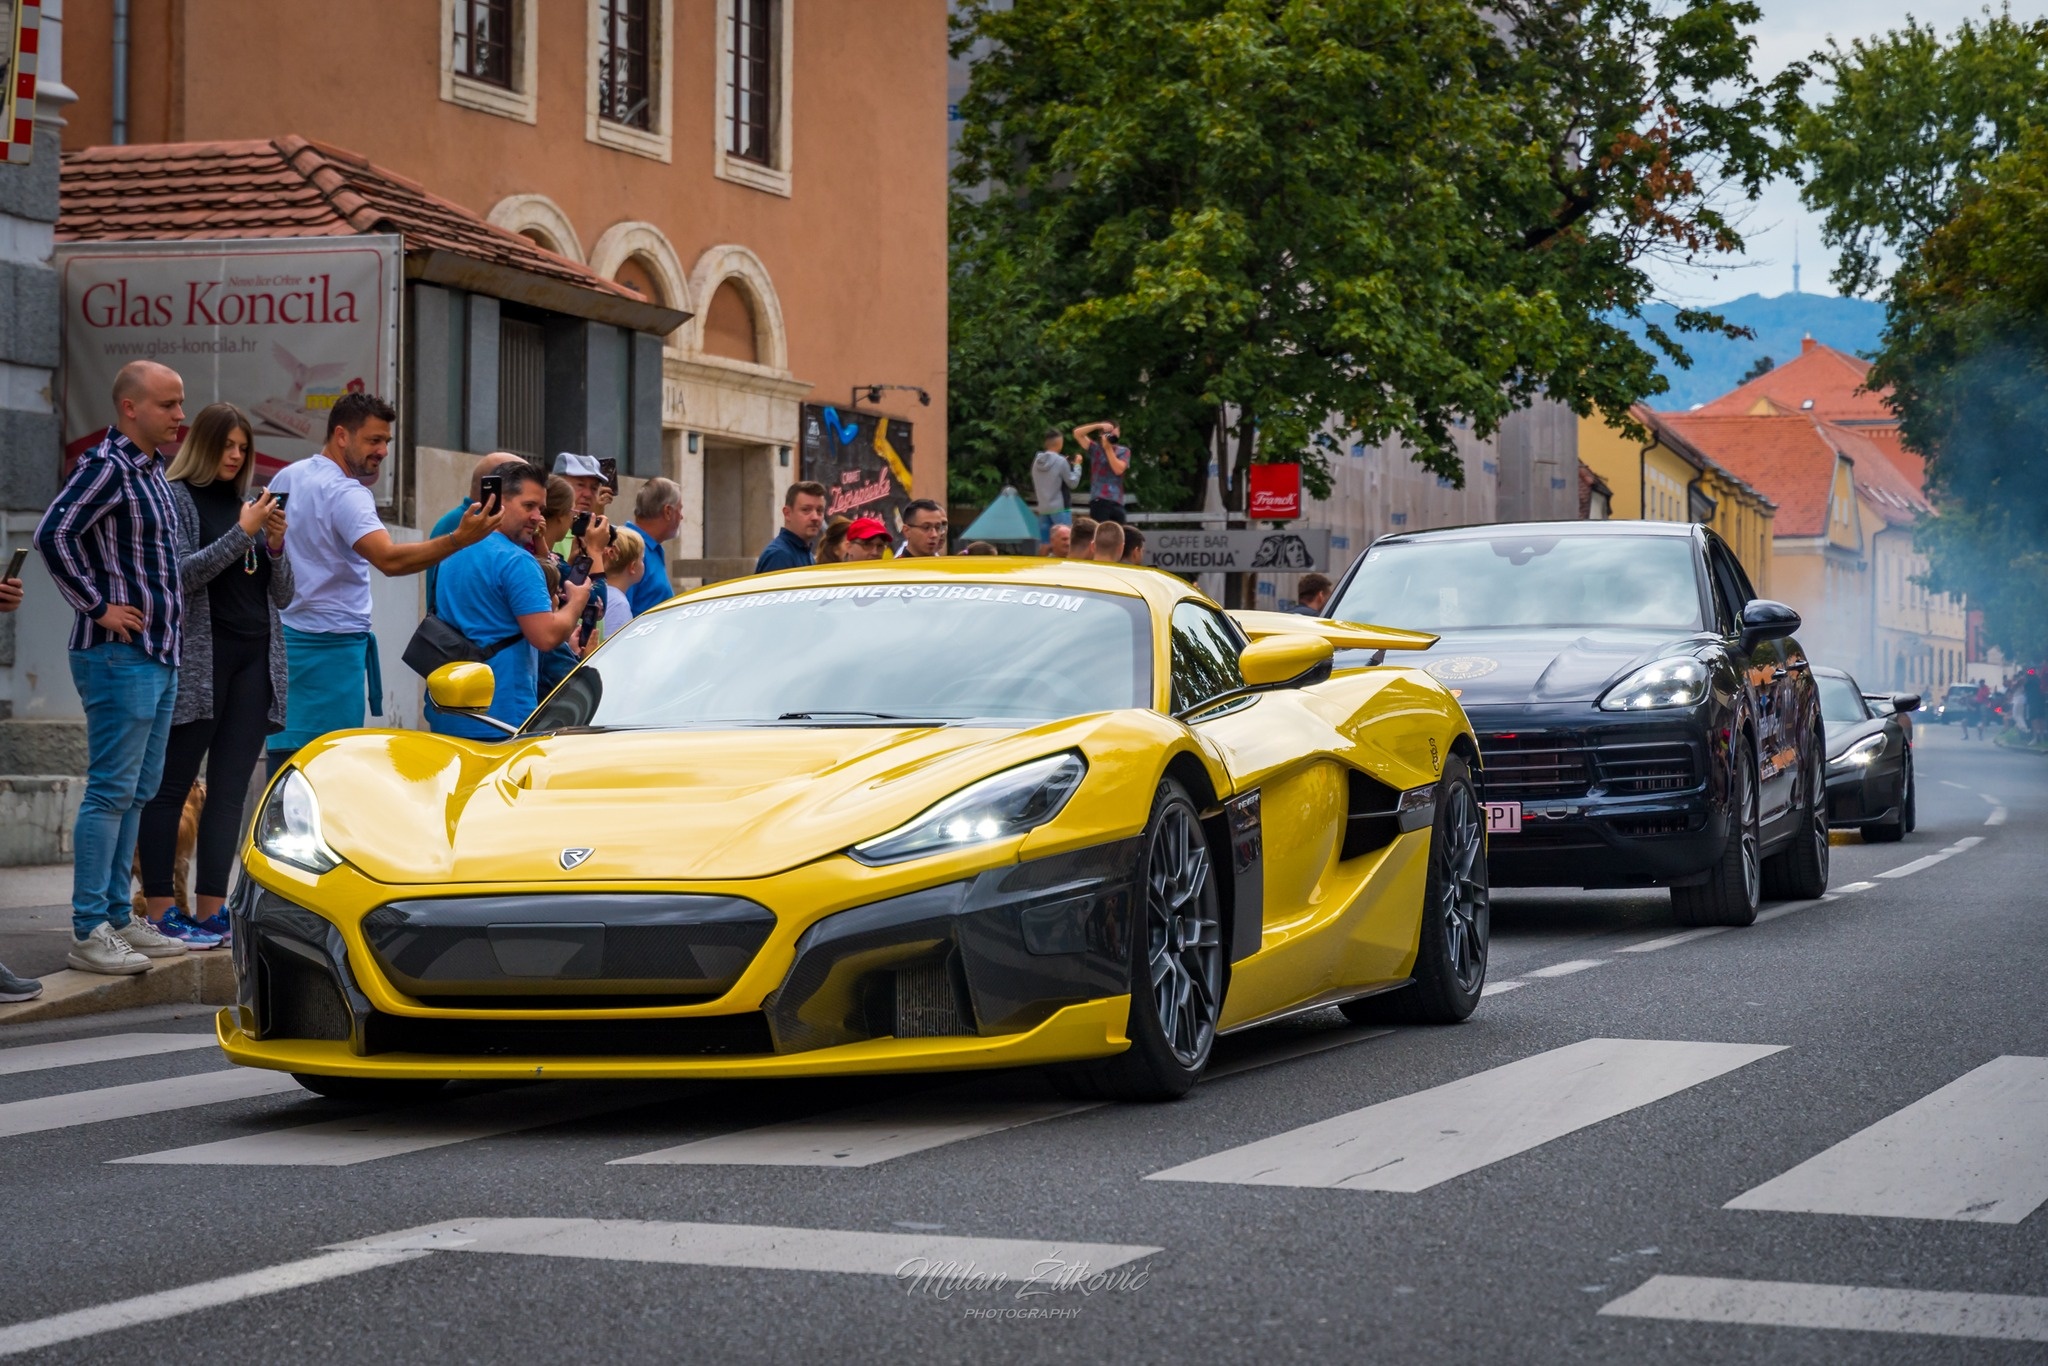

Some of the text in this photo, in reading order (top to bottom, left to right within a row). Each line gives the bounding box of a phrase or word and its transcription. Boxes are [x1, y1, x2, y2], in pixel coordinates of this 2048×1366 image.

[82, 274, 359, 328] Glas Koncila
[104, 336, 258, 358] www.glas-koncila.hr
[1252, 491, 1297, 506] Franck
[1159, 535, 1229, 549] CAFFE BAR
[677, 583, 1085, 620] SUPERCAROWNERSCIRCLE.COM
[625, 620, 663, 640] 56
